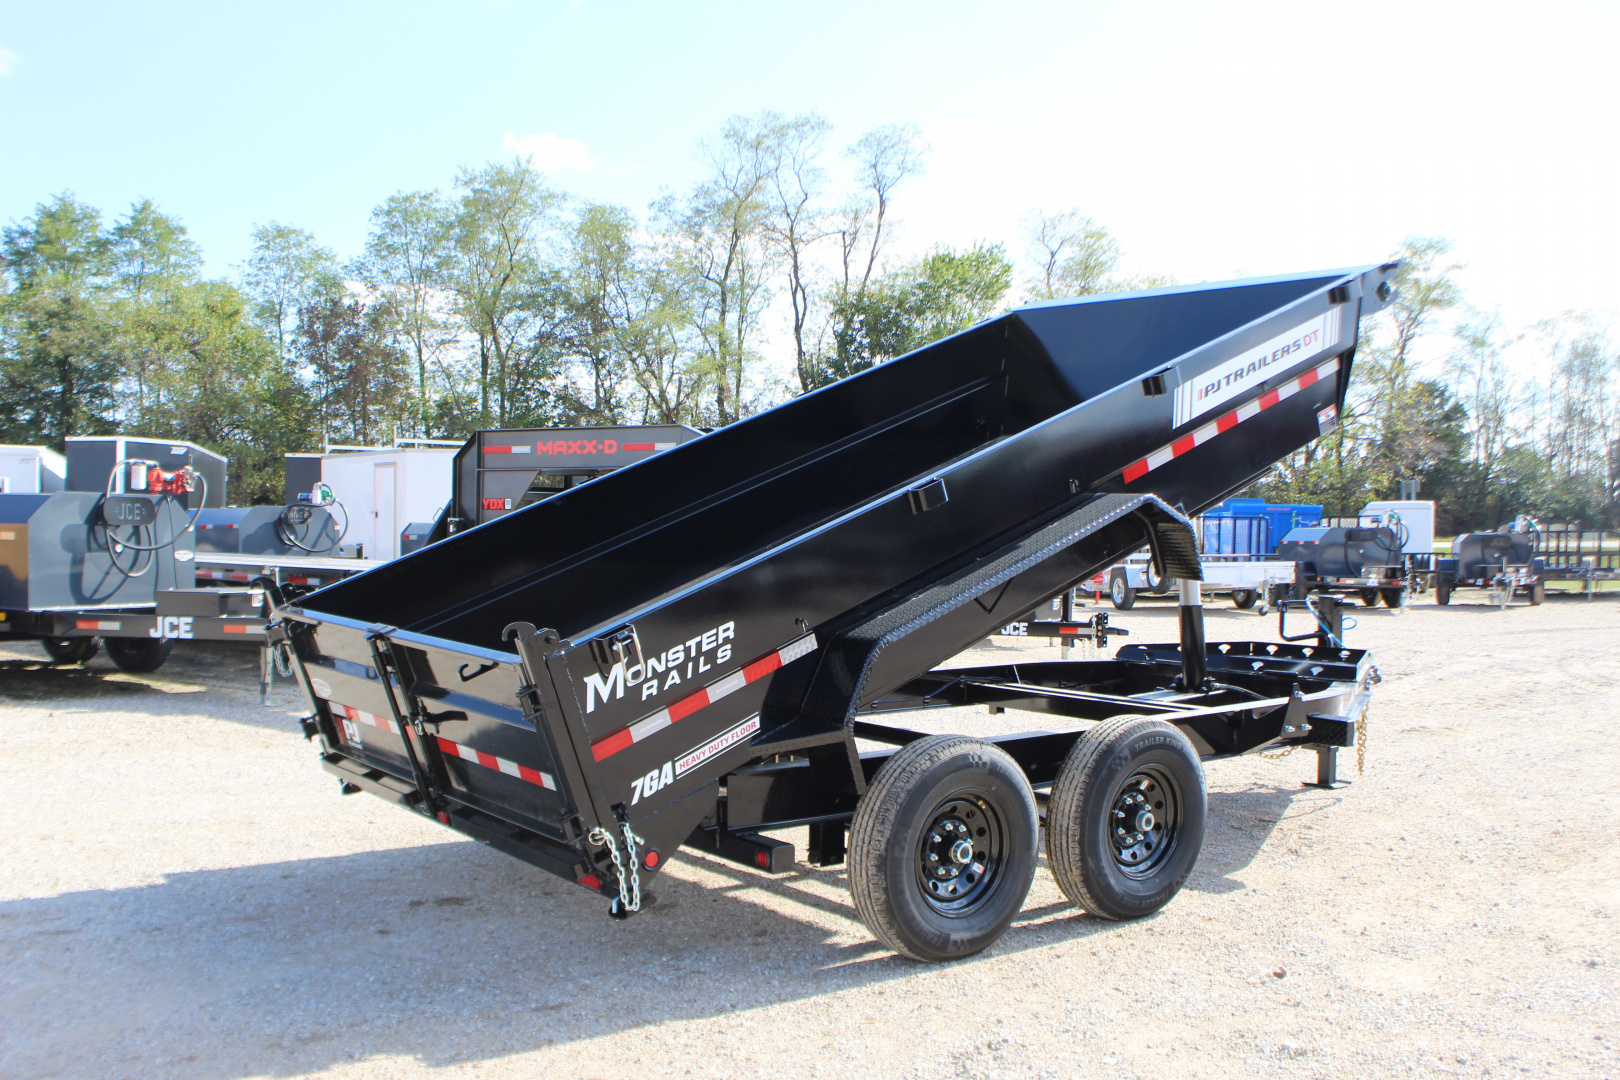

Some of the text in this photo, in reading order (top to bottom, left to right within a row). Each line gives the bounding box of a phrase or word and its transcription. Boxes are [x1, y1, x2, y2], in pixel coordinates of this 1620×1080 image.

[1302, 329, 1319, 347] DT
[537, 440, 617, 455] MAXX-D
[117, 503, 142, 521] JCE
[482, 499, 505, 510] YDX
[149, 616, 194, 639] JCE
[1001, 622, 1029, 636] JCE
[583, 621, 735, 714] MONSTER
[641, 644, 732, 701] RAILS
[342, 719, 361, 743] PJ
[1134, 736, 1182, 752] TRAILER KING
[631, 721, 757, 806] 7GA HEAVY DUTY FLOOR
